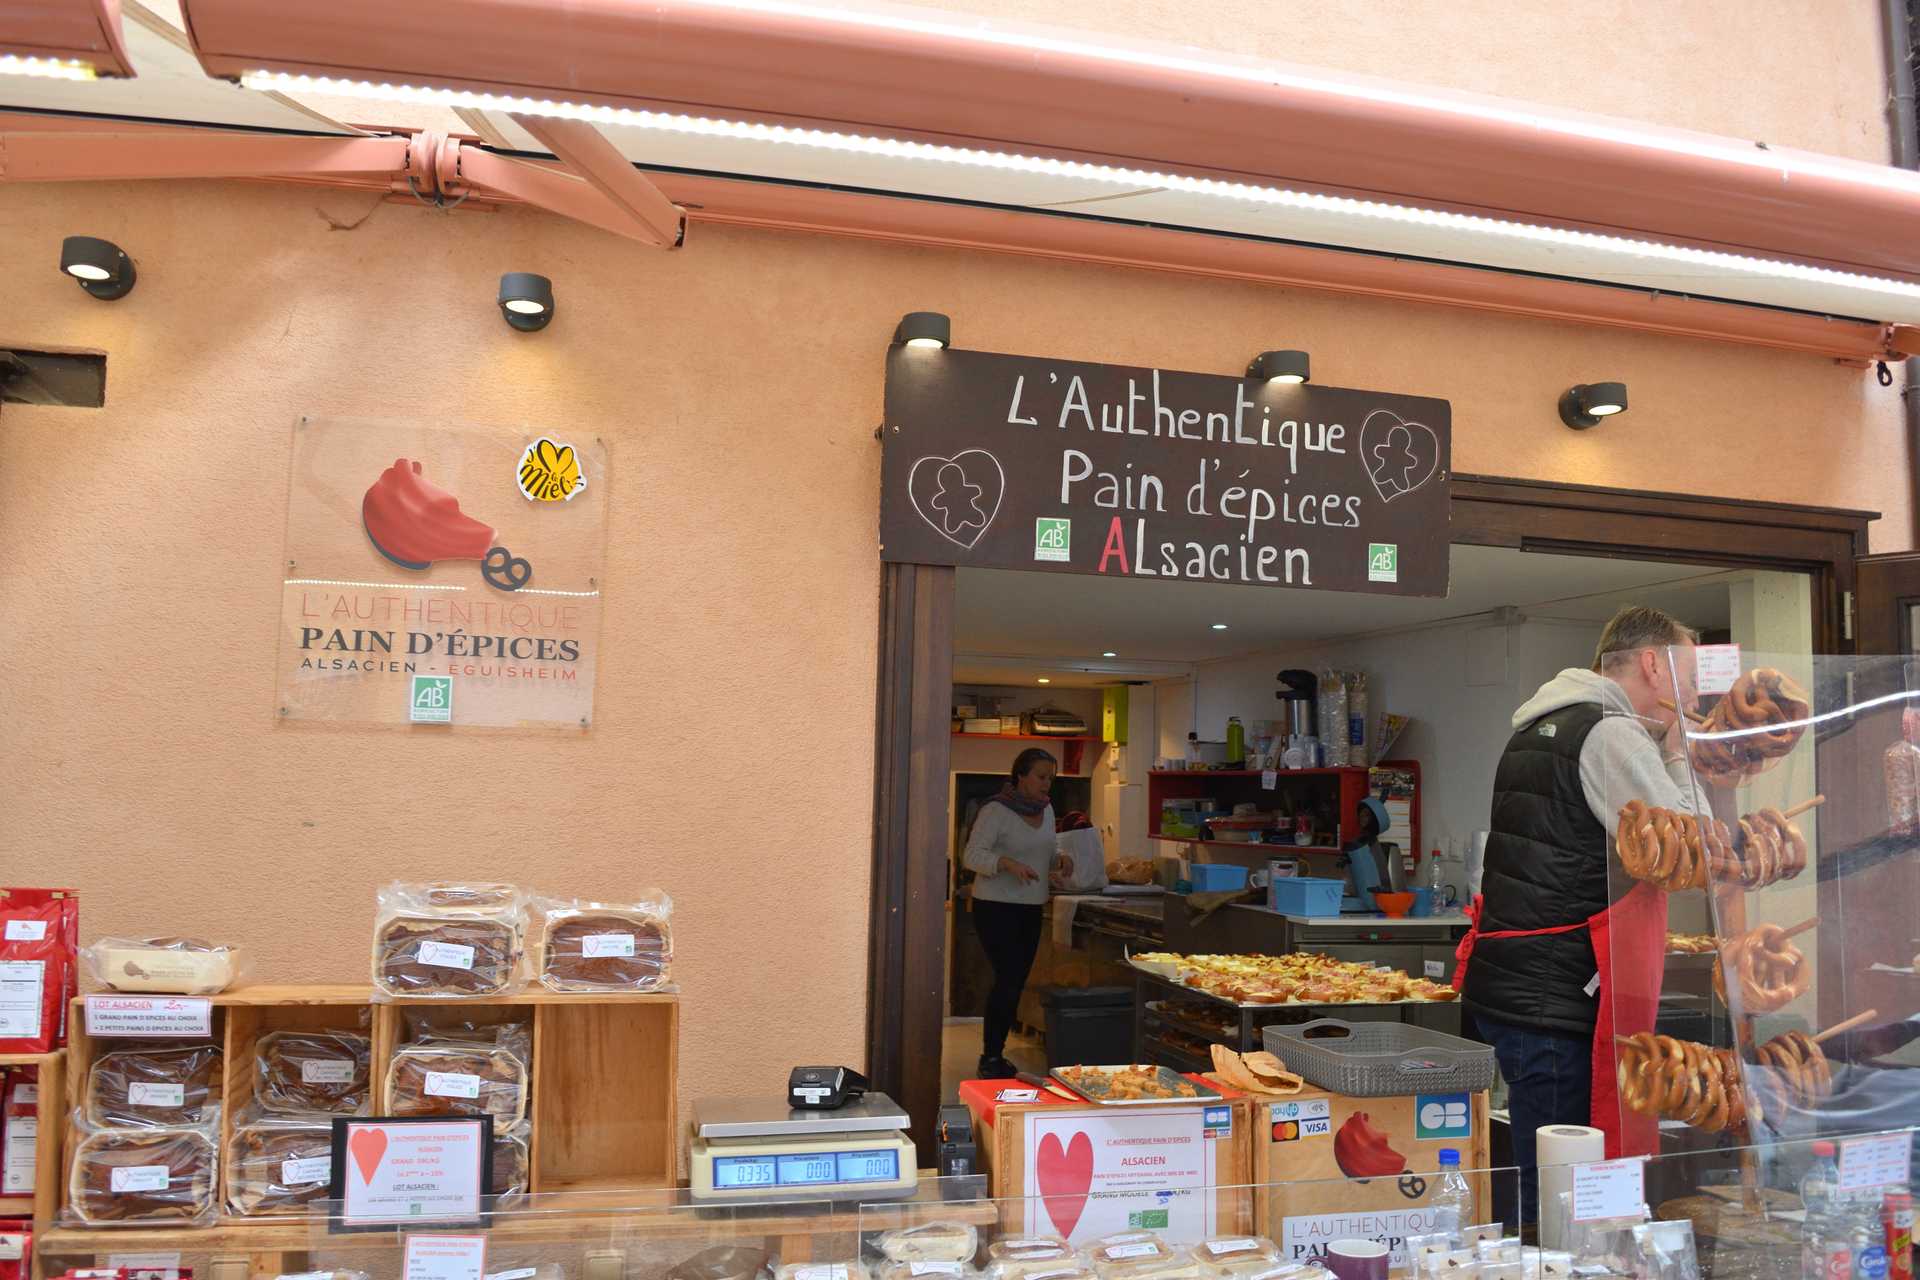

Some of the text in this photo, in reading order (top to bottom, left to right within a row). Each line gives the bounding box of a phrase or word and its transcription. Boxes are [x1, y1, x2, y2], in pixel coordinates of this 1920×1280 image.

[1007, 368, 1347, 474] L'Authentique
[1061, 448, 1361, 543] Pain d'épices
[1040, 528, 1065, 548] AB
[1371, 551, 1392, 570] AB
[302, 592, 578, 633] L'AUTHENTIQUE
[298, 626, 580, 662] PAIN D'ÉPICES
[300, 657, 417, 673] ALSACIEN
[448, 664, 577, 681] EGUISHEIM
[415, 686, 445, 708] AB
[1305, 1122, 1328, 1133] VISA
[1121, 1156, 1166, 1166] ALSACIEN
[1291, 1213, 1440, 1239] L'AUTHENTIQU
[1293, 1242, 1328, 1259] PAI
